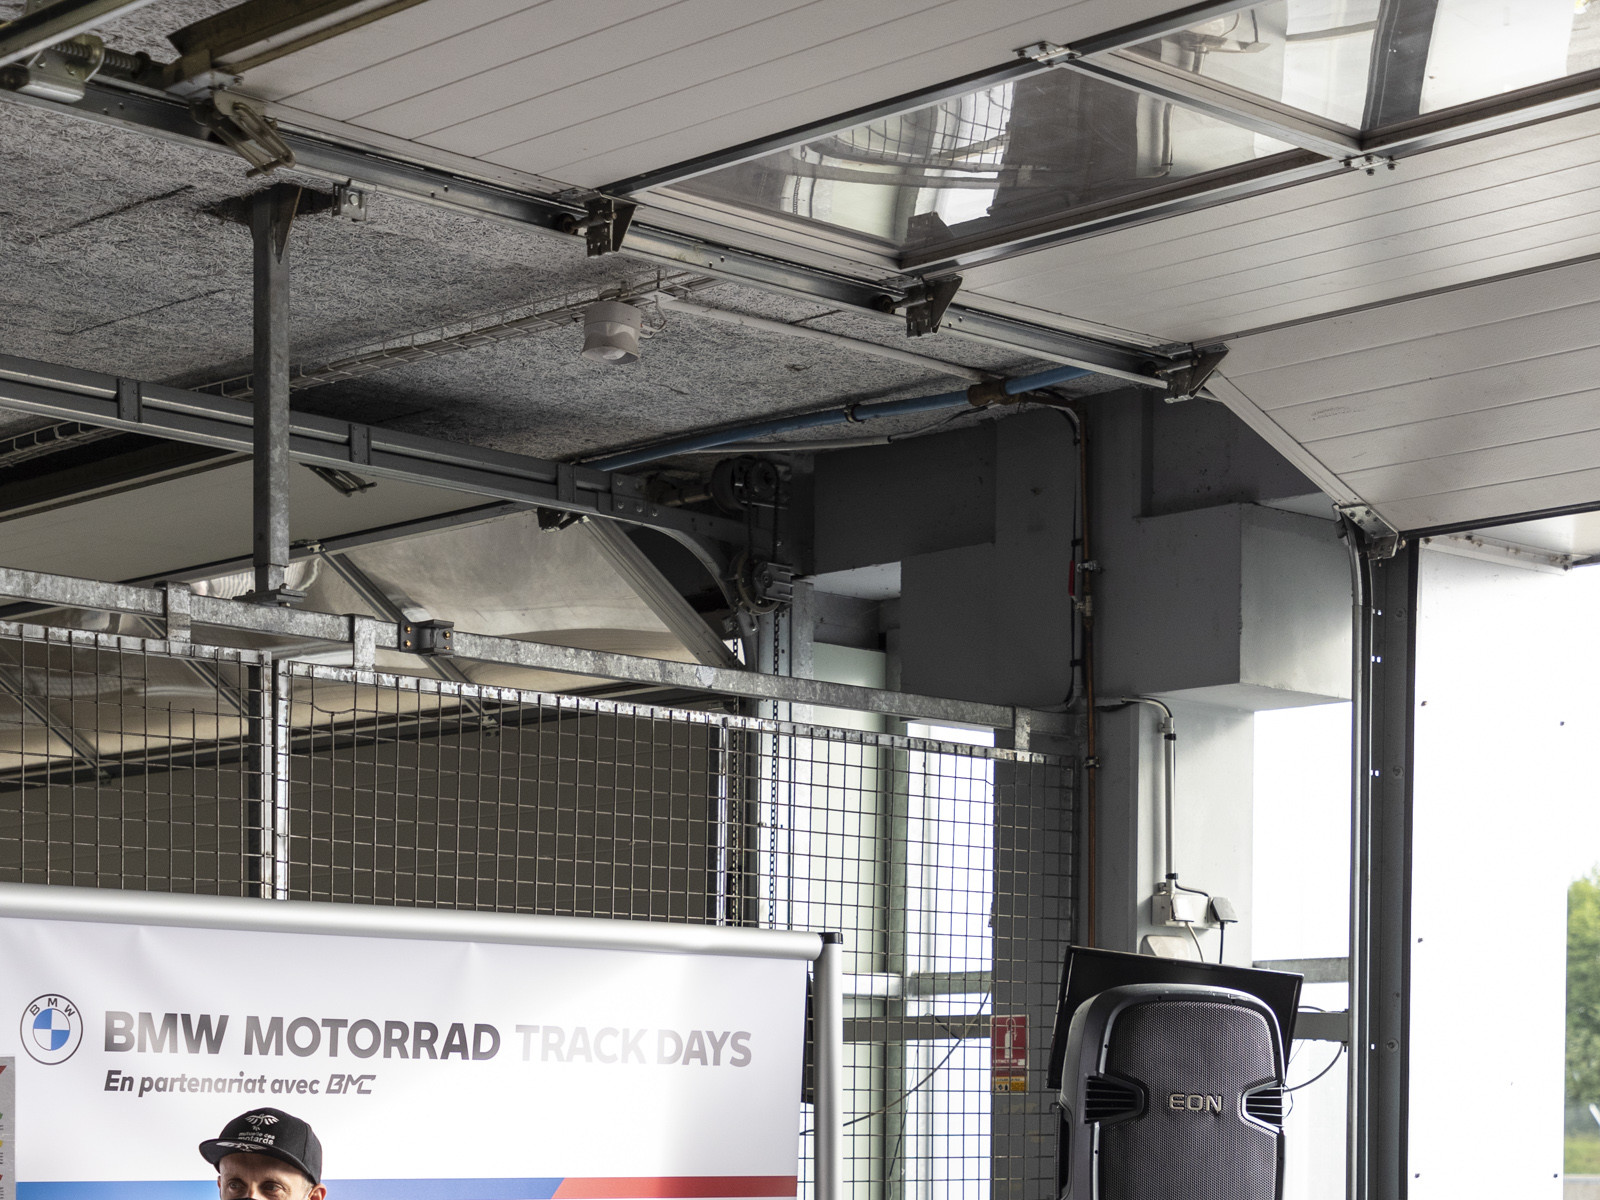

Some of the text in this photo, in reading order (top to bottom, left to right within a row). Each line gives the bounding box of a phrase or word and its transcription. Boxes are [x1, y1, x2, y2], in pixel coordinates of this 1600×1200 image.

[104, 1010, 752, 1068] BMW MOTORRAD TRACK DAYS
[104, 1069, 377, 1098] En partenariat avec BMC
[1168, 1094, 1222, 1113] EON
